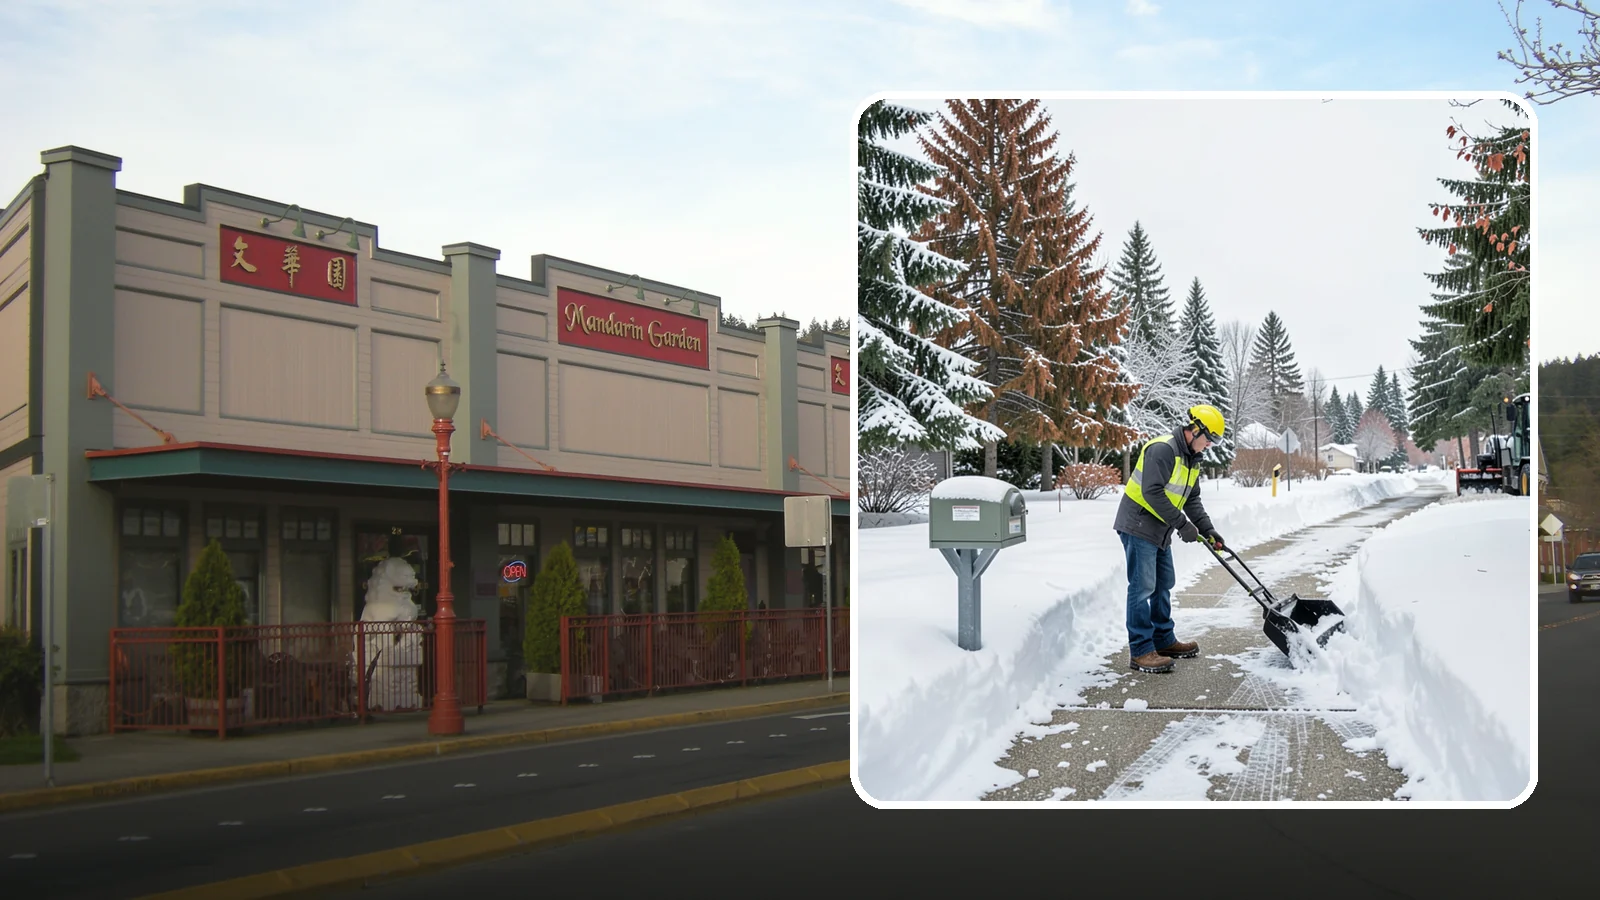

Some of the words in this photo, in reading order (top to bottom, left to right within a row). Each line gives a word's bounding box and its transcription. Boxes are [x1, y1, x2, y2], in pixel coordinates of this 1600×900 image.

[230, 235, 346, 291] 文華園
[564, 302, 644, 341] Mandarin
[647, 320, 702, 352] Garden
[503, 565, 527, 578] OPEN
